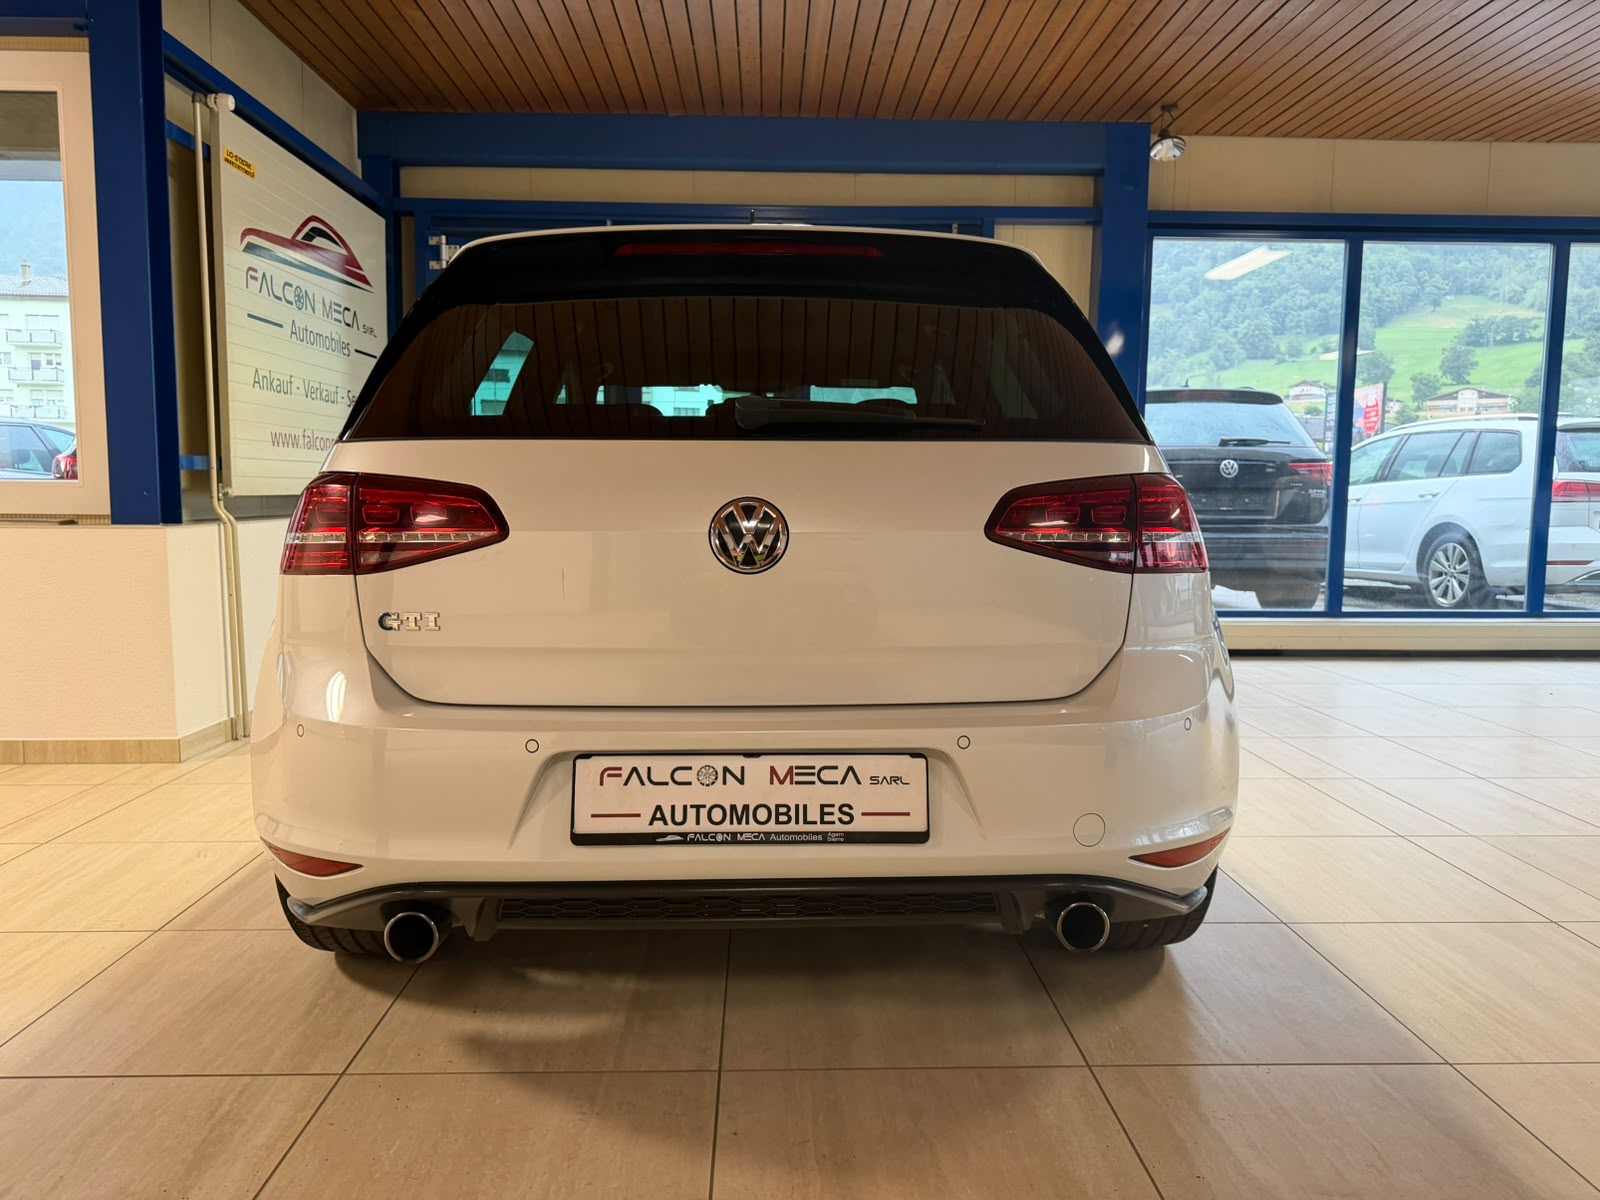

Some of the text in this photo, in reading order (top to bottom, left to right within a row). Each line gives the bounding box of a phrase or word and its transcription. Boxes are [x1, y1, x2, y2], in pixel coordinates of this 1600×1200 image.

[246, 266, 315, 314] FALCON
[322, 296, 360, 331] MECA
[290, 319, 351, 357] Automobiles
[252, 368, 293, 396] Ankauf
[303, 378, 339, 405] Verkauf
[378, 612, 441, 631] GTI
[599, 765, 911, 787] FALCON MECA SARL
[648, 803, 855, 827] AUTOMOBILES
[687, 832, 823, 842] FALCON MECA Automobiles
